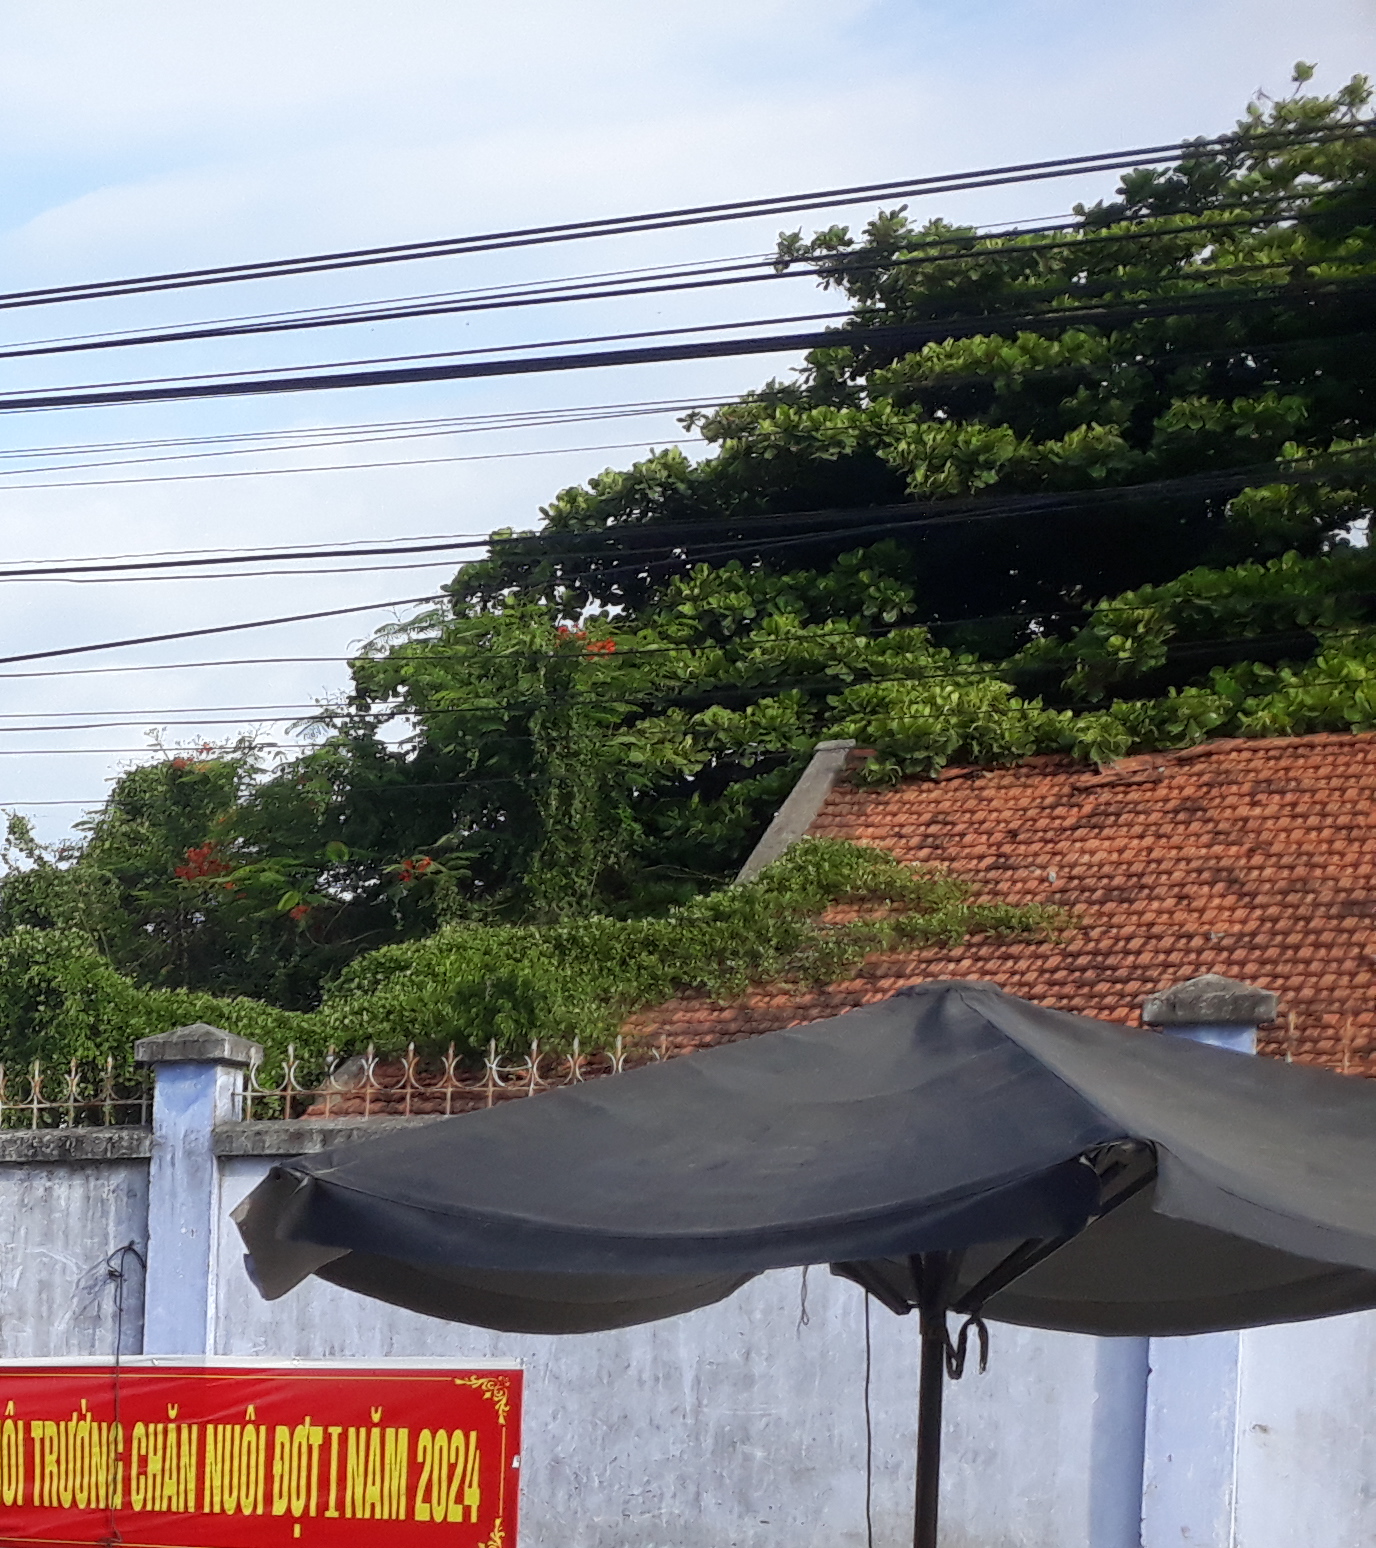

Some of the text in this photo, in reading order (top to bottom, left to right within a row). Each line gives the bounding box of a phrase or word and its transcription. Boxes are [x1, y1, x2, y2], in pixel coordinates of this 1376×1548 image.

[31, 1398, 124, 1509] TRƯỜNG
[131, 1402, 198, 1513] CHĂN
[203, 1404, 266, 1516] NUÔI
[271, 1415, 323, 1538] ĐỢT
[324, 1426, 343, 1518] I
[345, 1406, 409, 1520] NĂM
[414, 1428, 481, 1523] 2024
